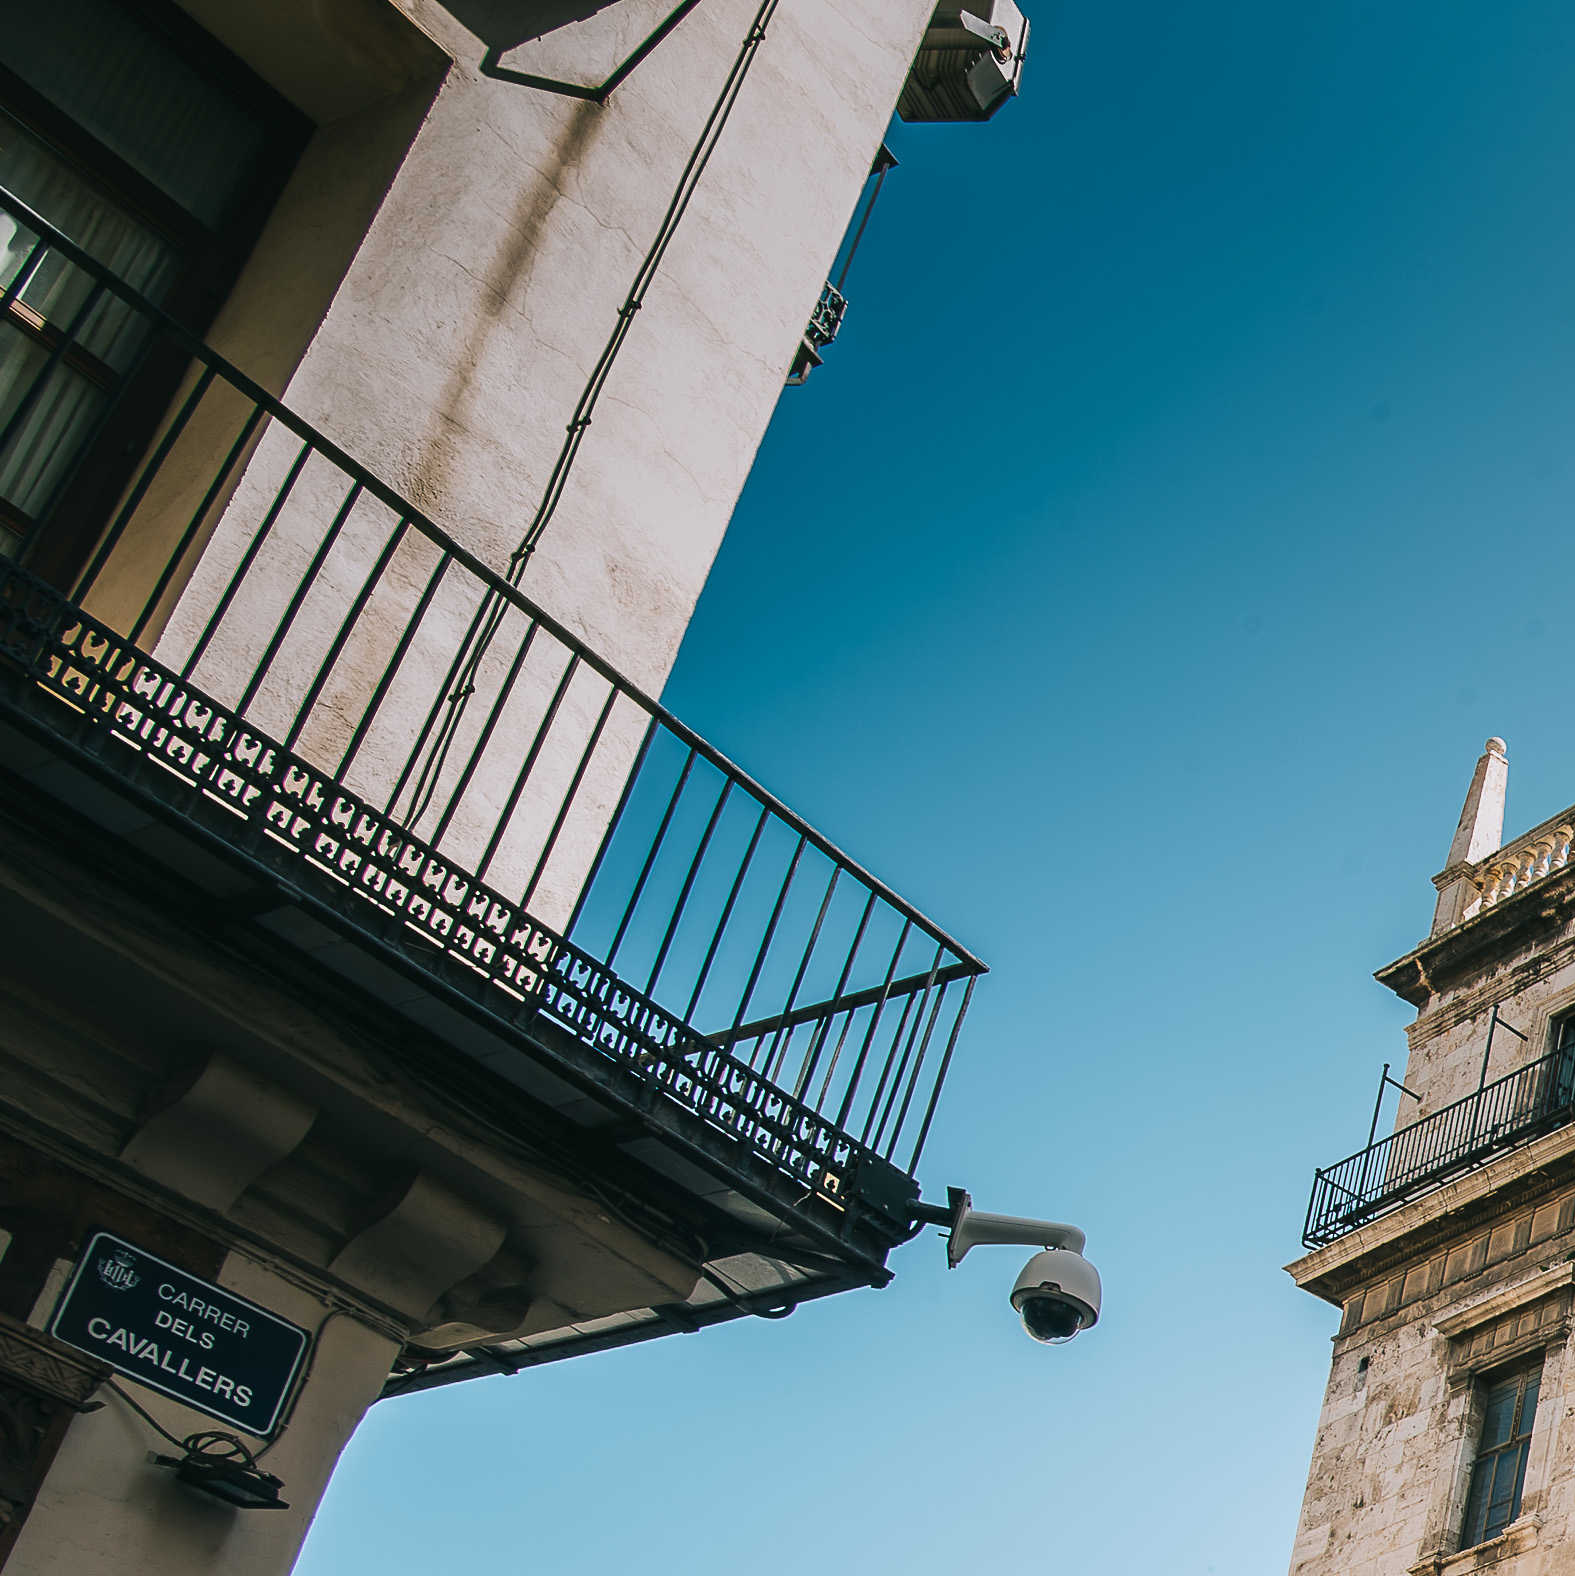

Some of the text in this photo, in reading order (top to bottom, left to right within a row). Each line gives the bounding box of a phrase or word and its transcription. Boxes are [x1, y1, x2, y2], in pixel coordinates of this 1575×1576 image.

[154, 1310, 216, 1350] DELS
[158, 1283, 251, 1339] CARRER
[87, 1317, 253, 1407] CAVALLERS
